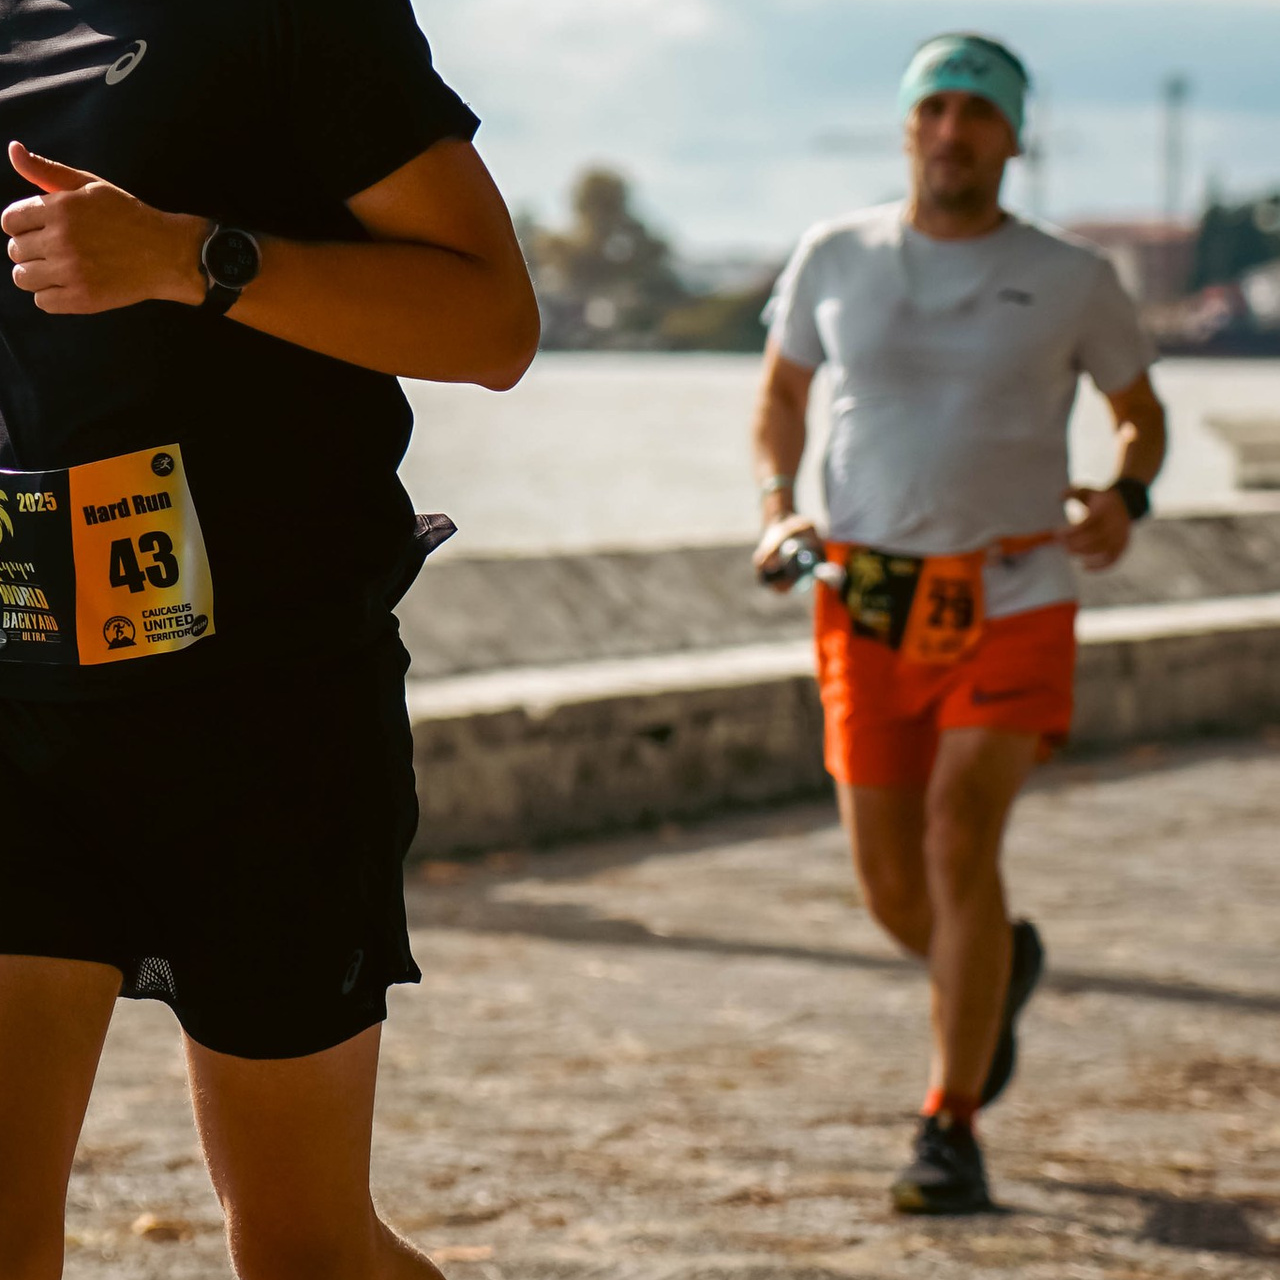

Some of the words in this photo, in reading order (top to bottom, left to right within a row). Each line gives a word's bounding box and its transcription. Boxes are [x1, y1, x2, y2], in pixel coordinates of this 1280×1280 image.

[16, 491, 58, 513] 2025
[82, 497, 132, 526] Hard
[131, 491, 173, 516] Run
[109, 530, 180, 594] 43
[141, 602, 192, 619] CAUCASUS
[2, 611, 59, 632] BACKYARD
[143, 613, 194, 632] UNITED
[21, 631, 47, 642] ULTRA
[144, 627, 193, 643] TERRITOR
